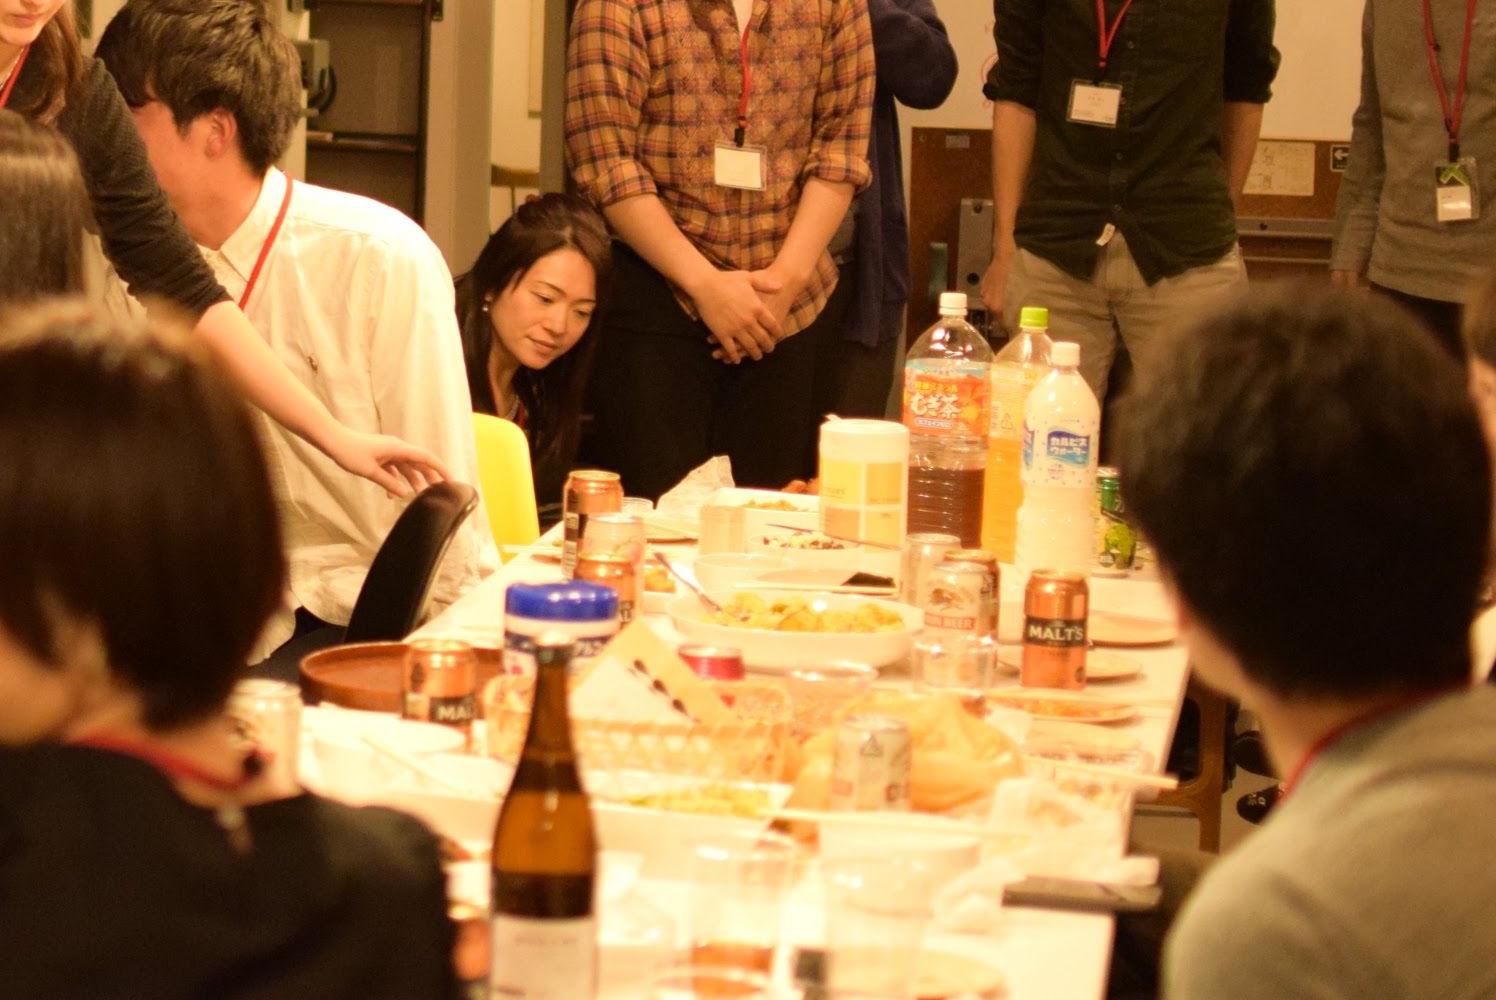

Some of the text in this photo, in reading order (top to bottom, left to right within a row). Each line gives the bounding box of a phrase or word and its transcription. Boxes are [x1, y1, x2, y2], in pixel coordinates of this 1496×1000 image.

[910, 392, 963, 420] むぎ茶
[1050, 437, 1088, 447] カルピス
[1029, 625, 1084, 641] MALT'S
